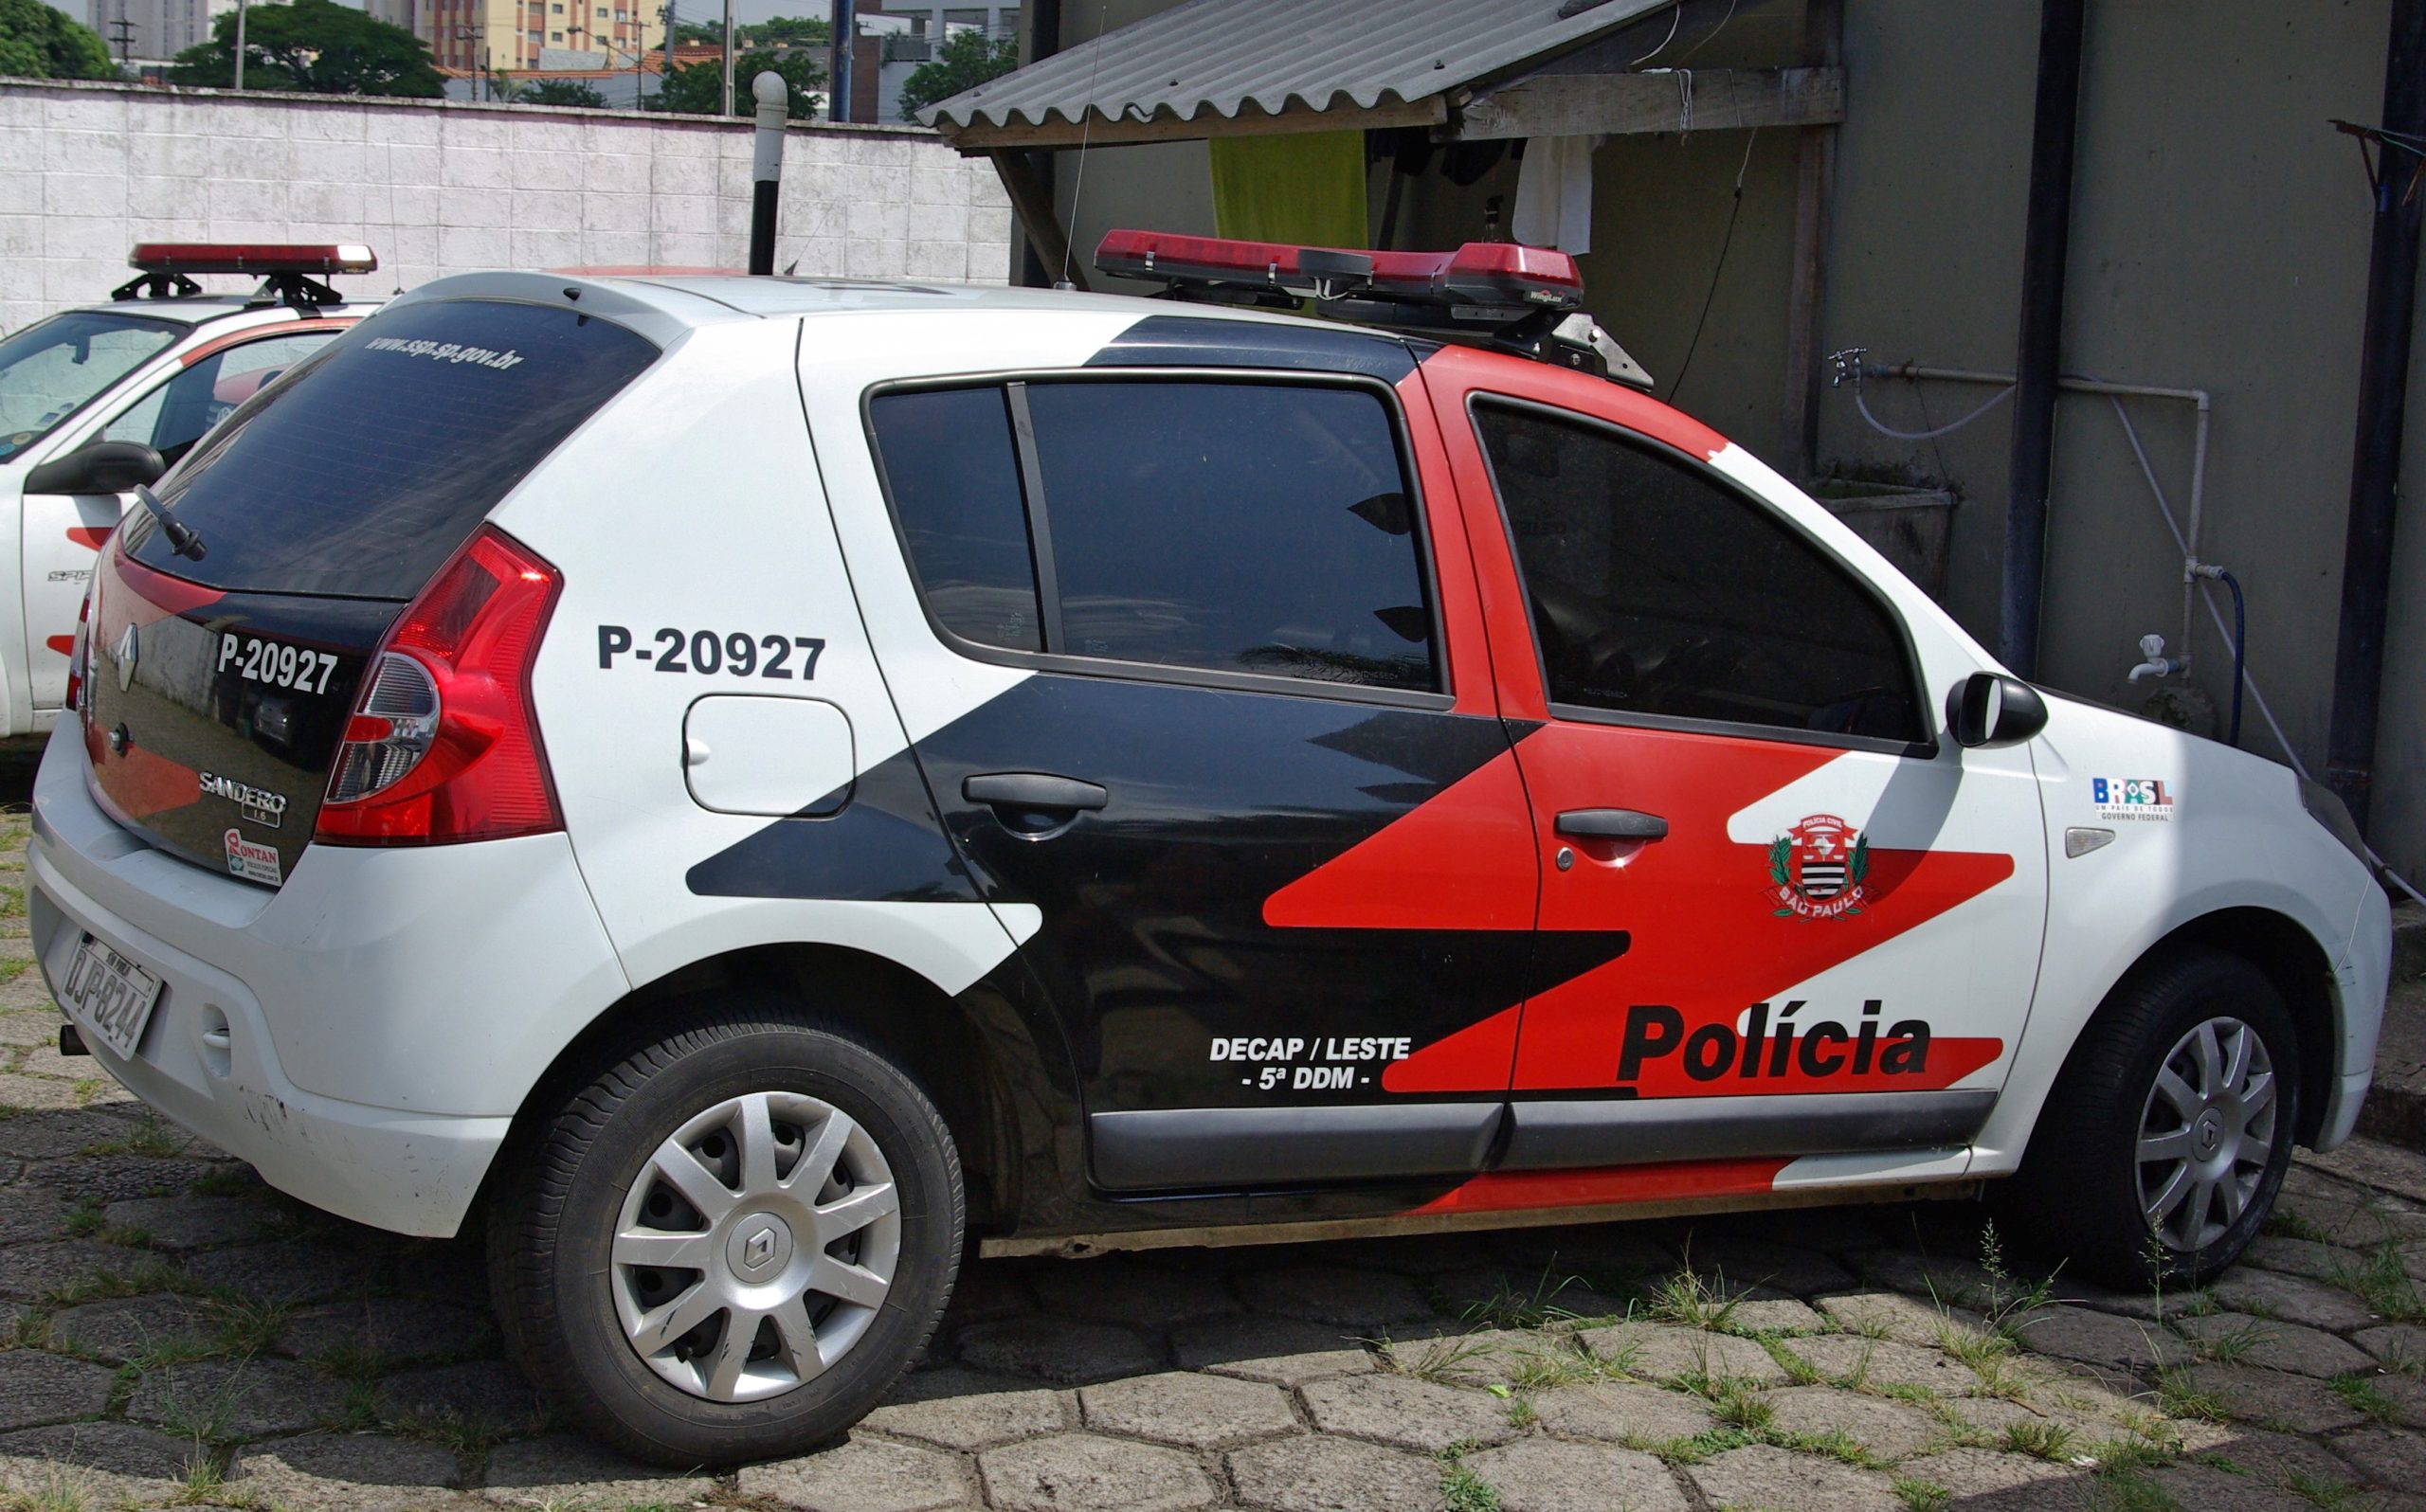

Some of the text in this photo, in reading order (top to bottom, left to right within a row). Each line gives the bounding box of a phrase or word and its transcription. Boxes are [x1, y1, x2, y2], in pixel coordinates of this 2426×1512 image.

[364, 336, 525, 370] www.ssp.sp.gov.br
[217, 633, 338, 695] P-20927
[598, 624, 825, 681] P-20927
[198, 771, 286, 814] SANDERO
[2101, 812, 2136, 820] GOVERNO
[1812, 885, 1864, 917] PAULO
[1210, 1037, 1411, 1061] DECAP / LESTE
[1617, 999, 1931, 1082] Polícia
[1258, 1067, 1287, 1089] 5ª
[1294, 1067, 1355, 1089] DDM
